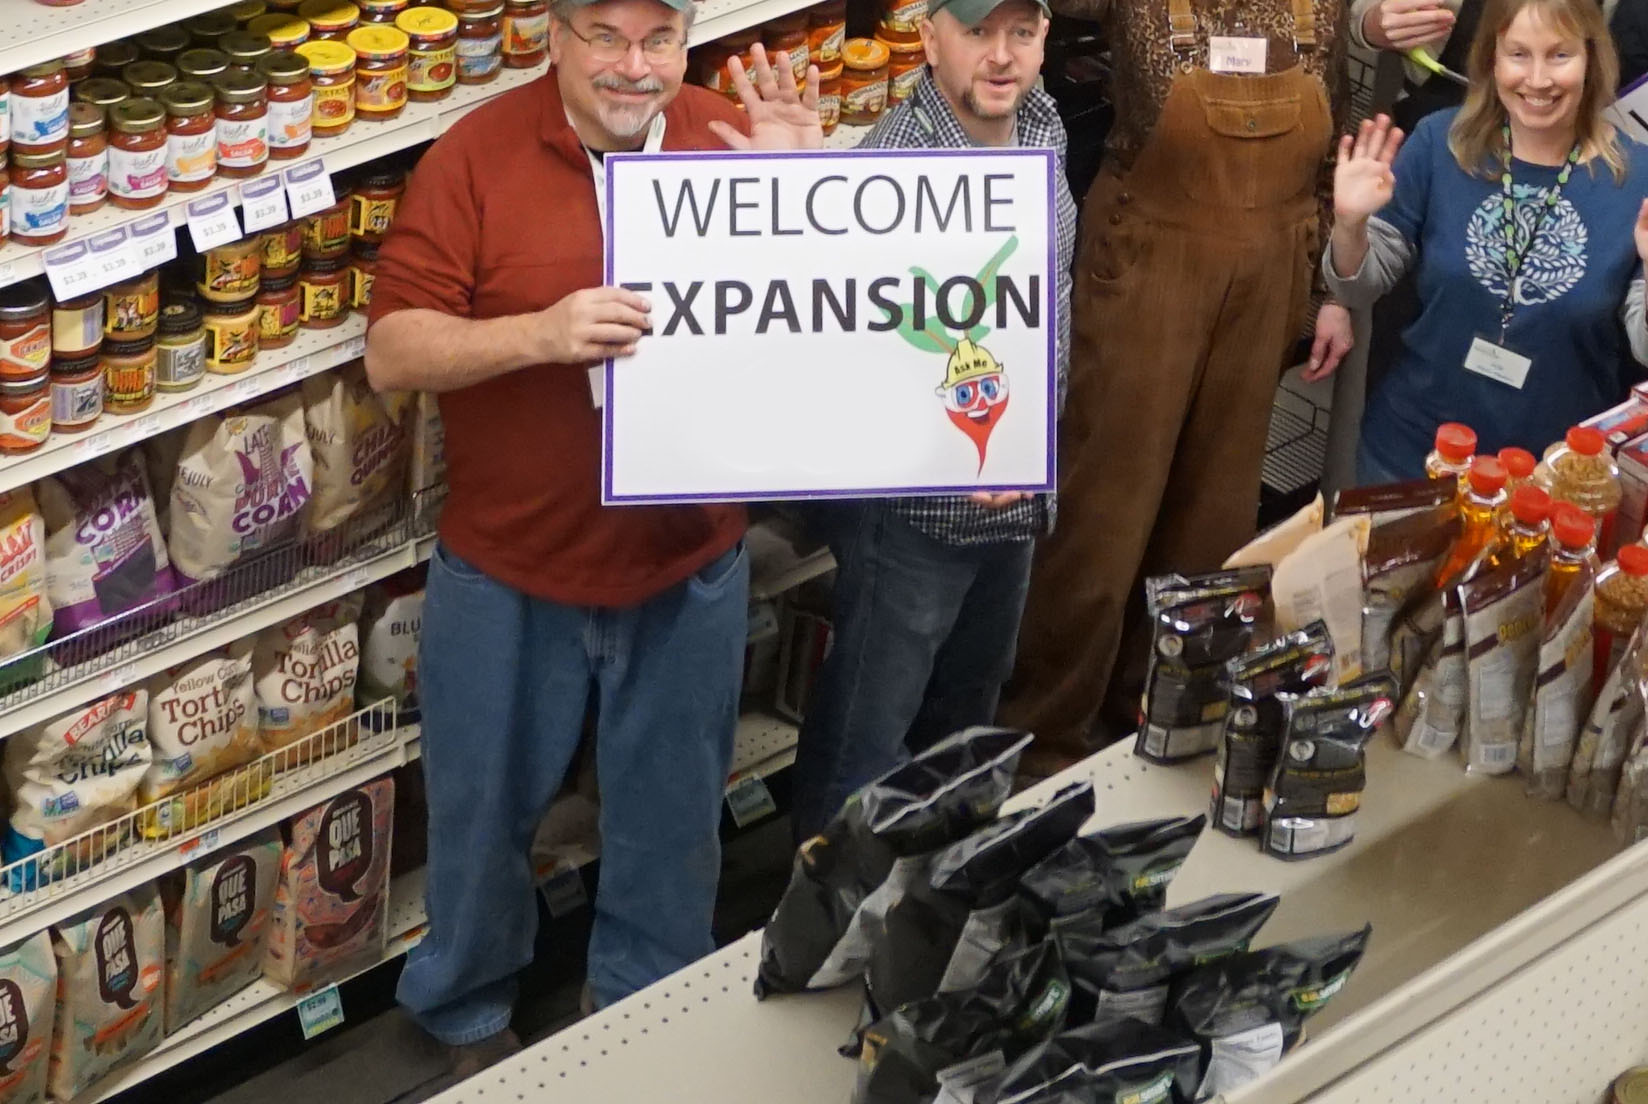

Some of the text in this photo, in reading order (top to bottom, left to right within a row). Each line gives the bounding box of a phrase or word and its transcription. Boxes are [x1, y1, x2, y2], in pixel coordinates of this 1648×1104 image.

[652, 172, 1017, 238] WELCOME
[954, 359, 988, 376] Ask Me
[232, 481, 311, 534] CORN
[390, 618, 422, 637] BLU
[171, 672, 216, 696] Yellow
[280, 667, 356, 706] Chips
[178, 694, 246, 747] Chips
[328, 812, 361, 846] QUE
[218, 867, 248, 898] QUE
[217, 892, 248, 924] PASA
